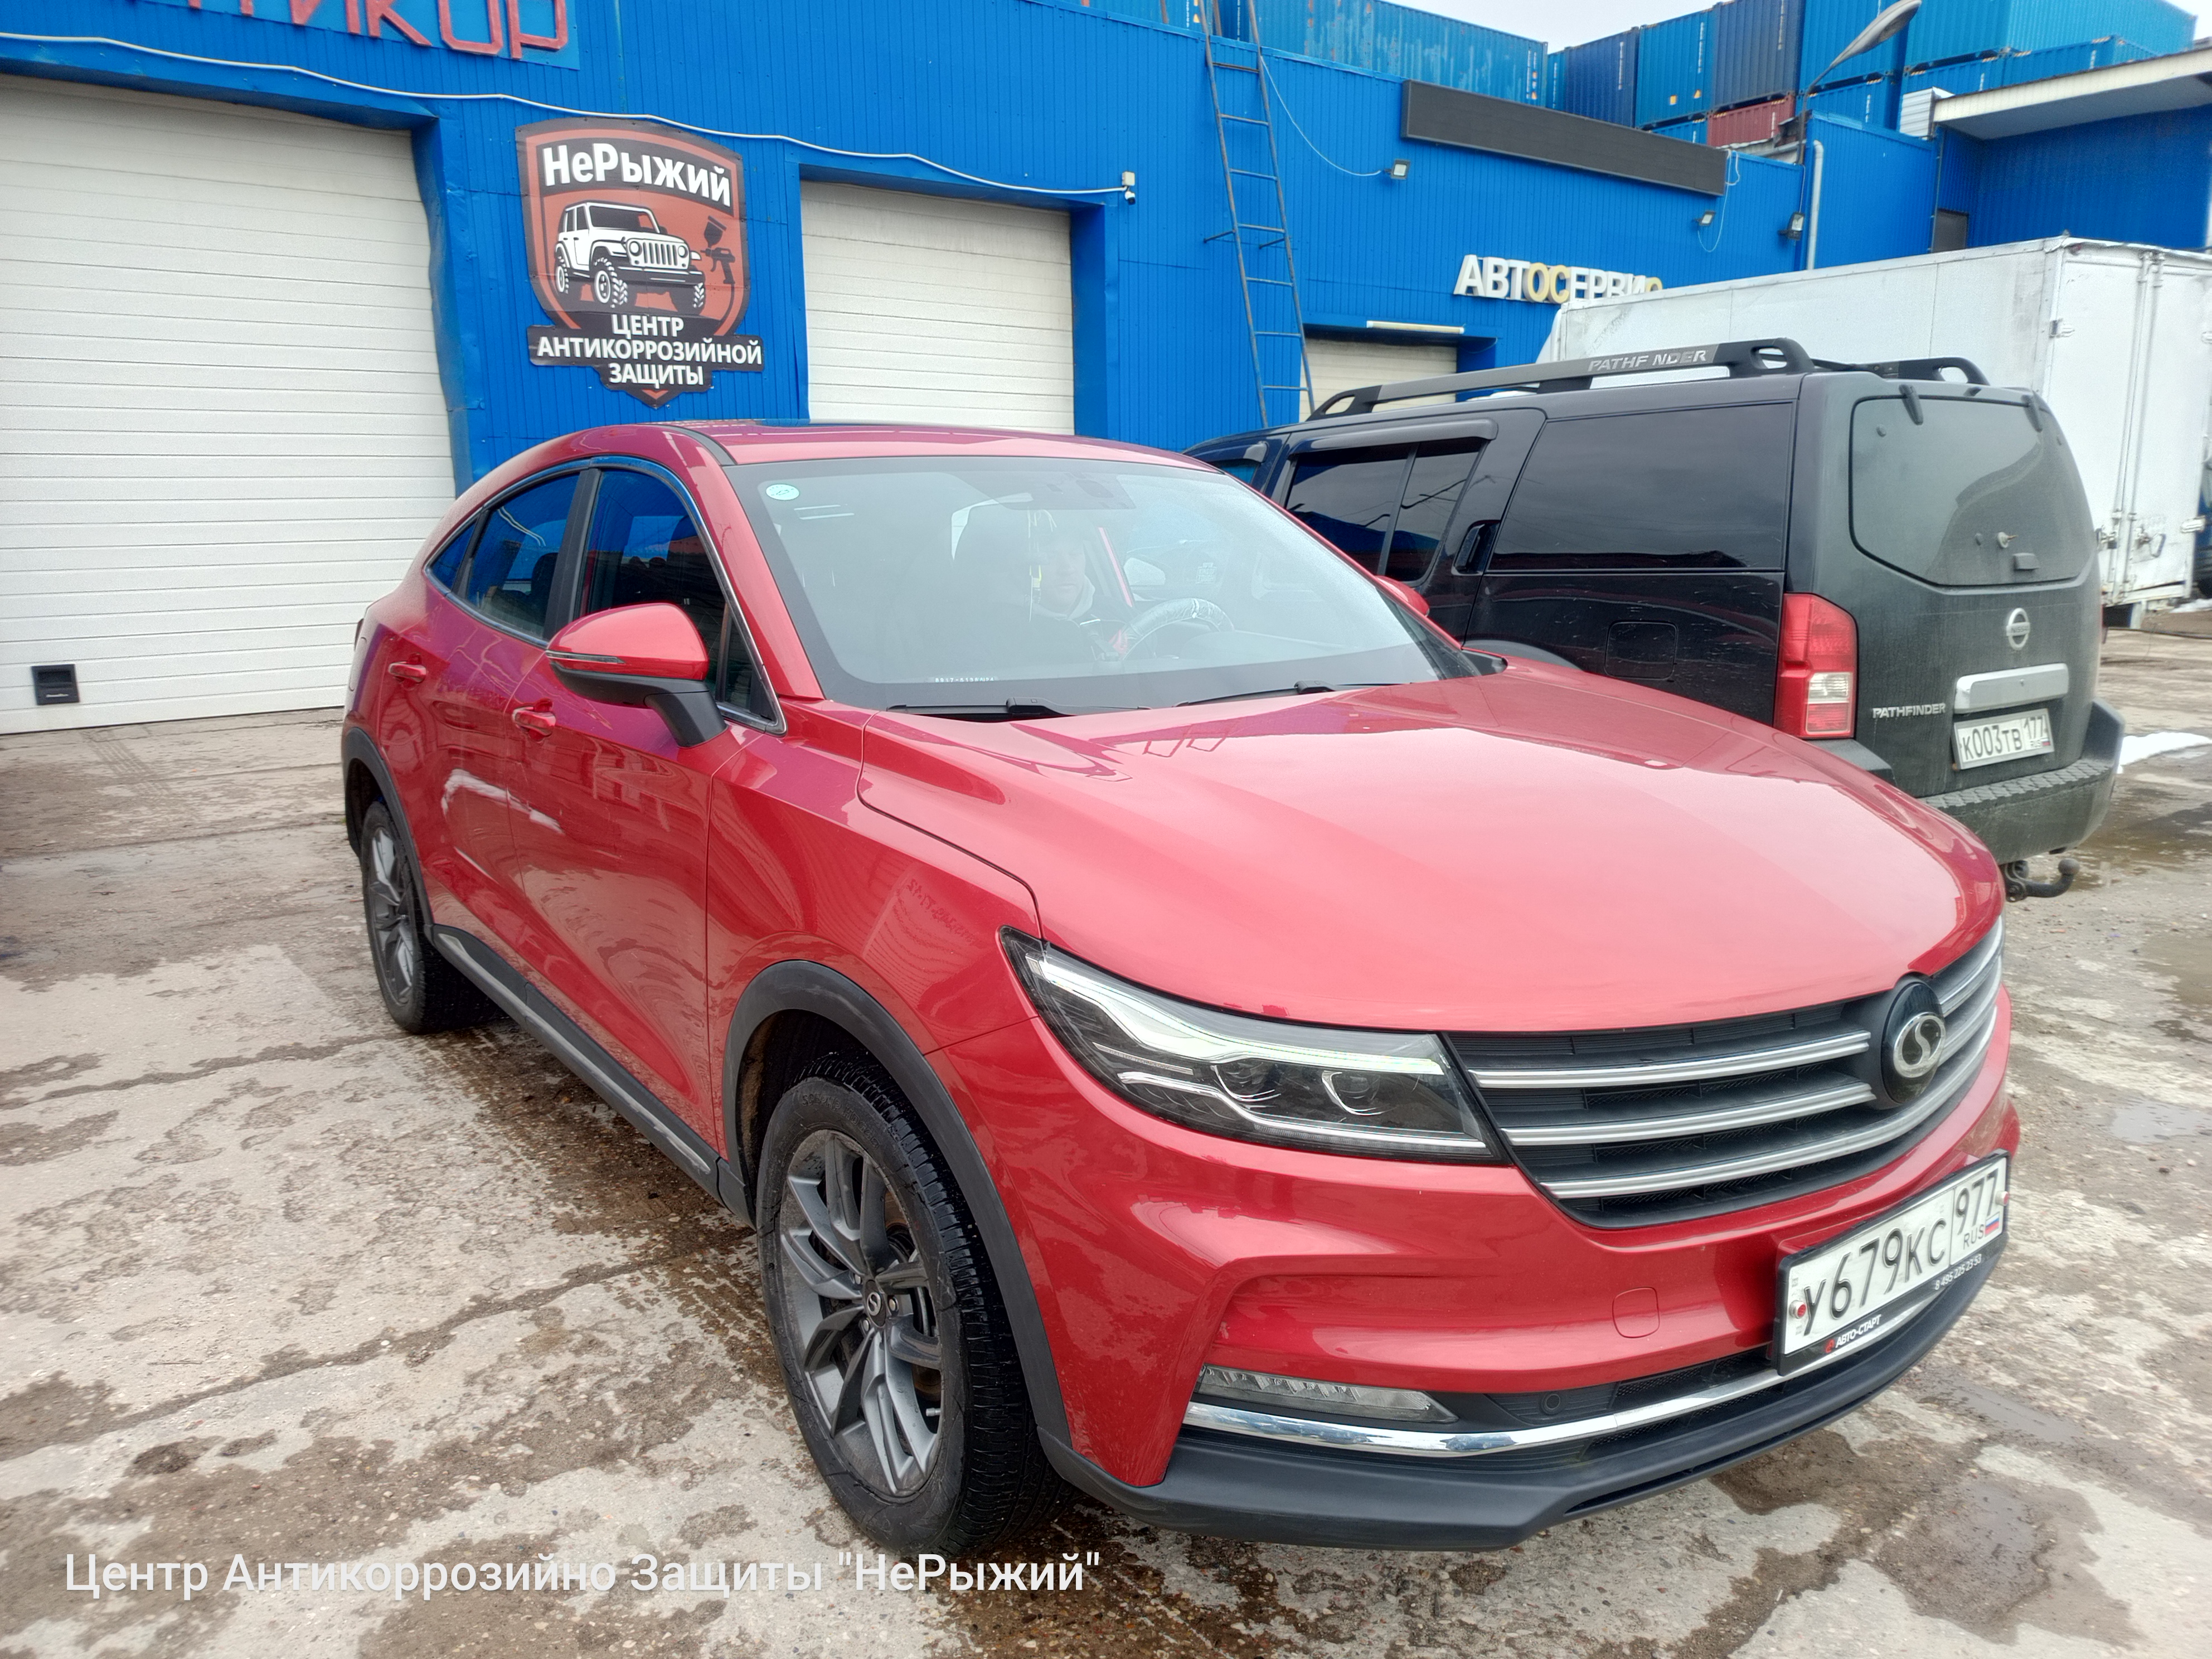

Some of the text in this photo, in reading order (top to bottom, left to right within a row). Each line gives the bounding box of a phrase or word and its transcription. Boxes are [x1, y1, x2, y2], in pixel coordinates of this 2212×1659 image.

[542, 143, 731, 207] НеРыжий
[611, 314, 684, 339] ЦЕНТР
[537, 336, 762, 365] АНТИКОРРОЗИЙНОЙ
[609, 363, 704, 389] ЗАЩИТЫ
[1873, 703, 1946, 718] PATHFINDER
[2024, 716, 2044, 740] 177
[1963, 1223, 1985, 1250] RUS
[1803, 1167, 1999, 1336] У679КС 977
[1935, 1253, 1982, 1290] 8 495 225 23 53
[1835, 1314, 1881, 1348] АВТО-СТАРТ
